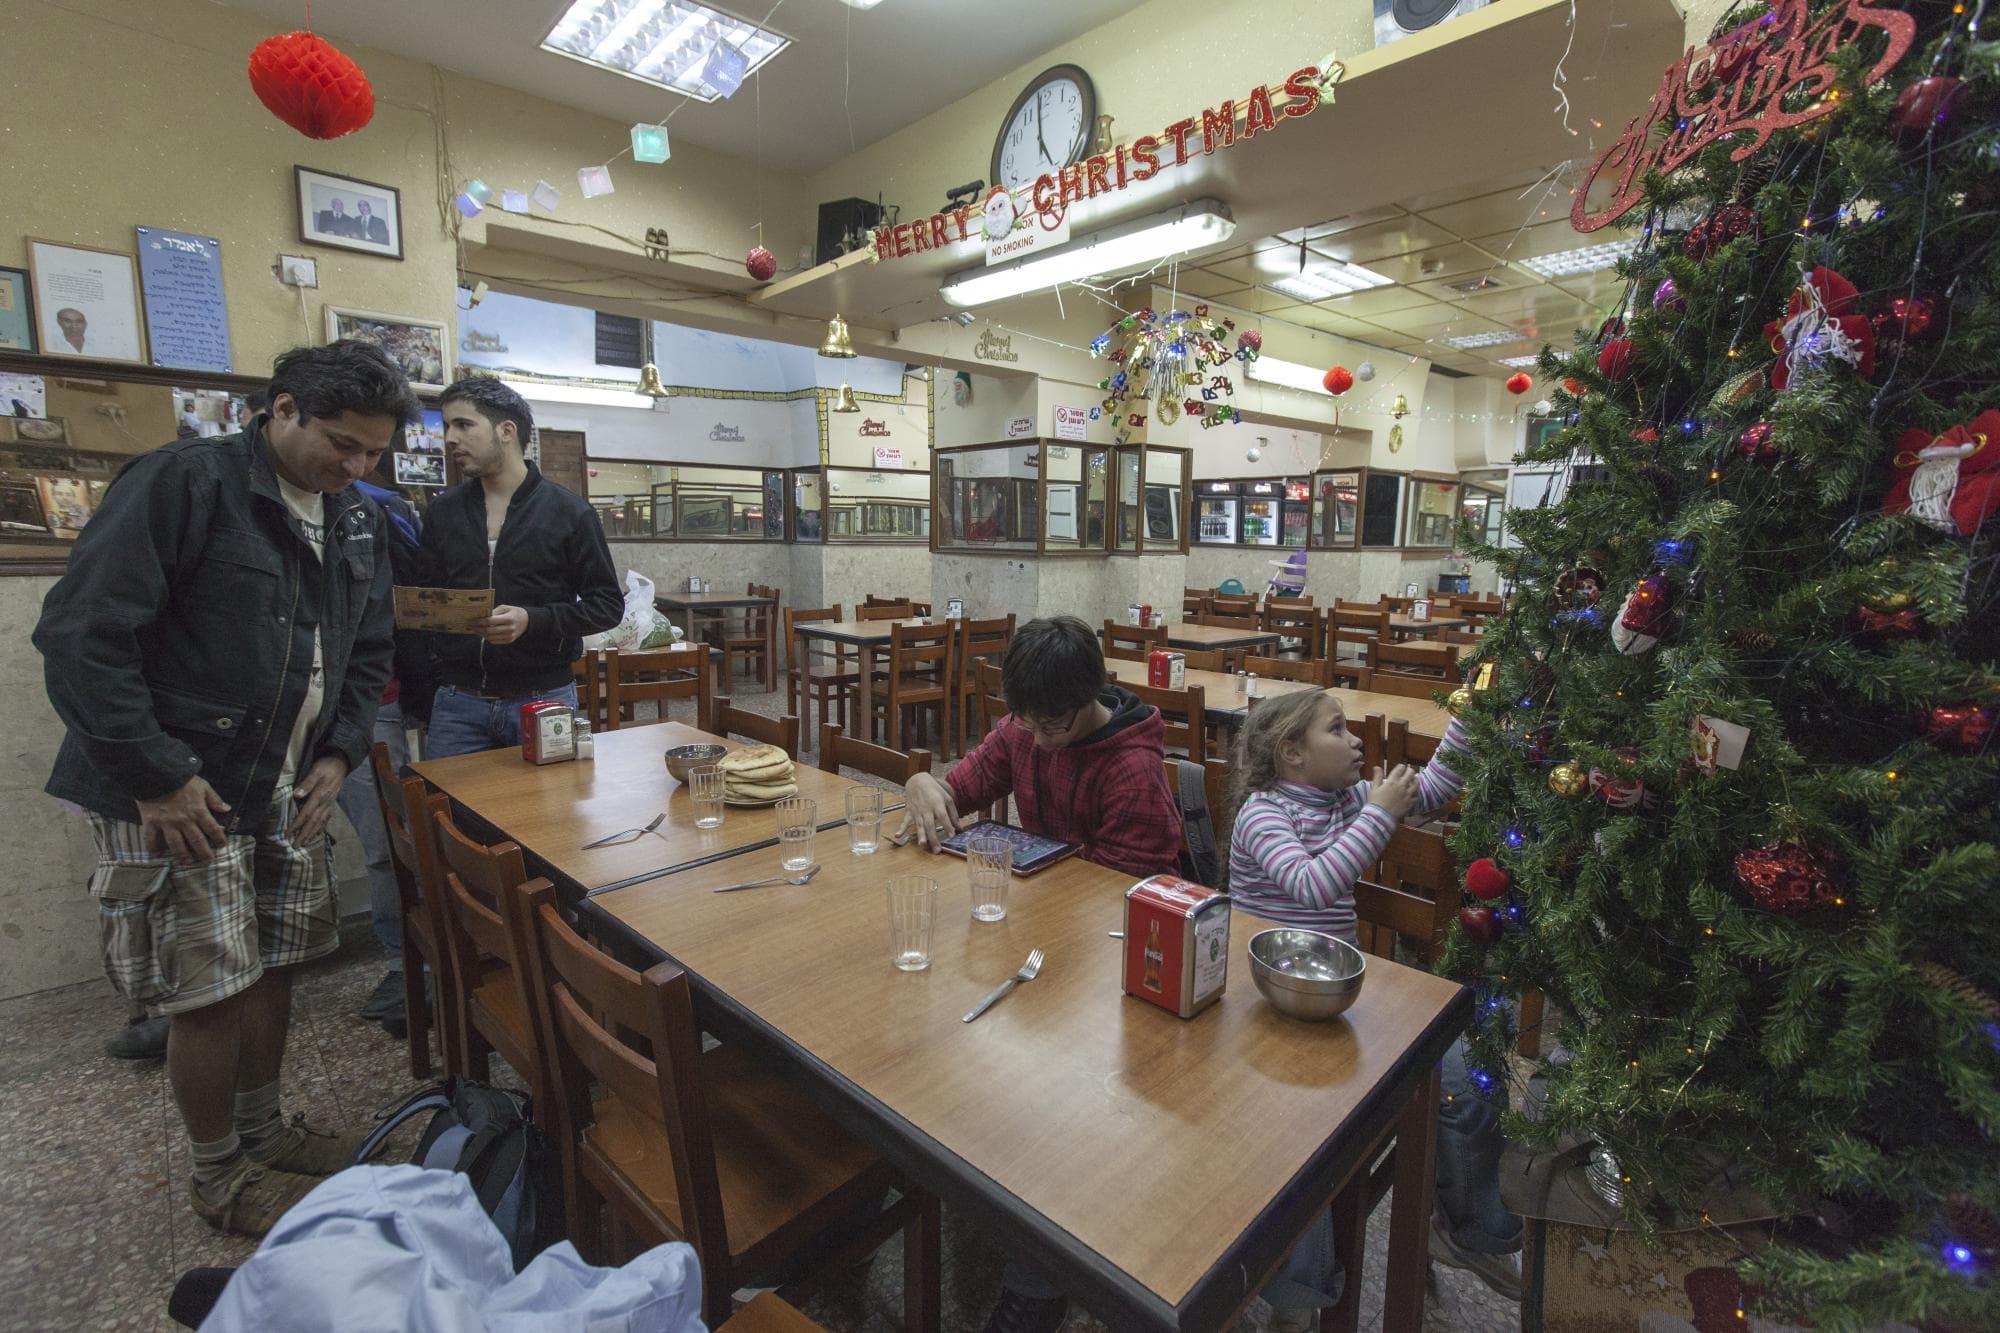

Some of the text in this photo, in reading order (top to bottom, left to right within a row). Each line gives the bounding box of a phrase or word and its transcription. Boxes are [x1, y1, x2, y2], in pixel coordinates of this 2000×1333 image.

[875, 65, 1321, 260] MERRY CHRISTMAS
[991, 235, 1034, 257] NO SMOKING
